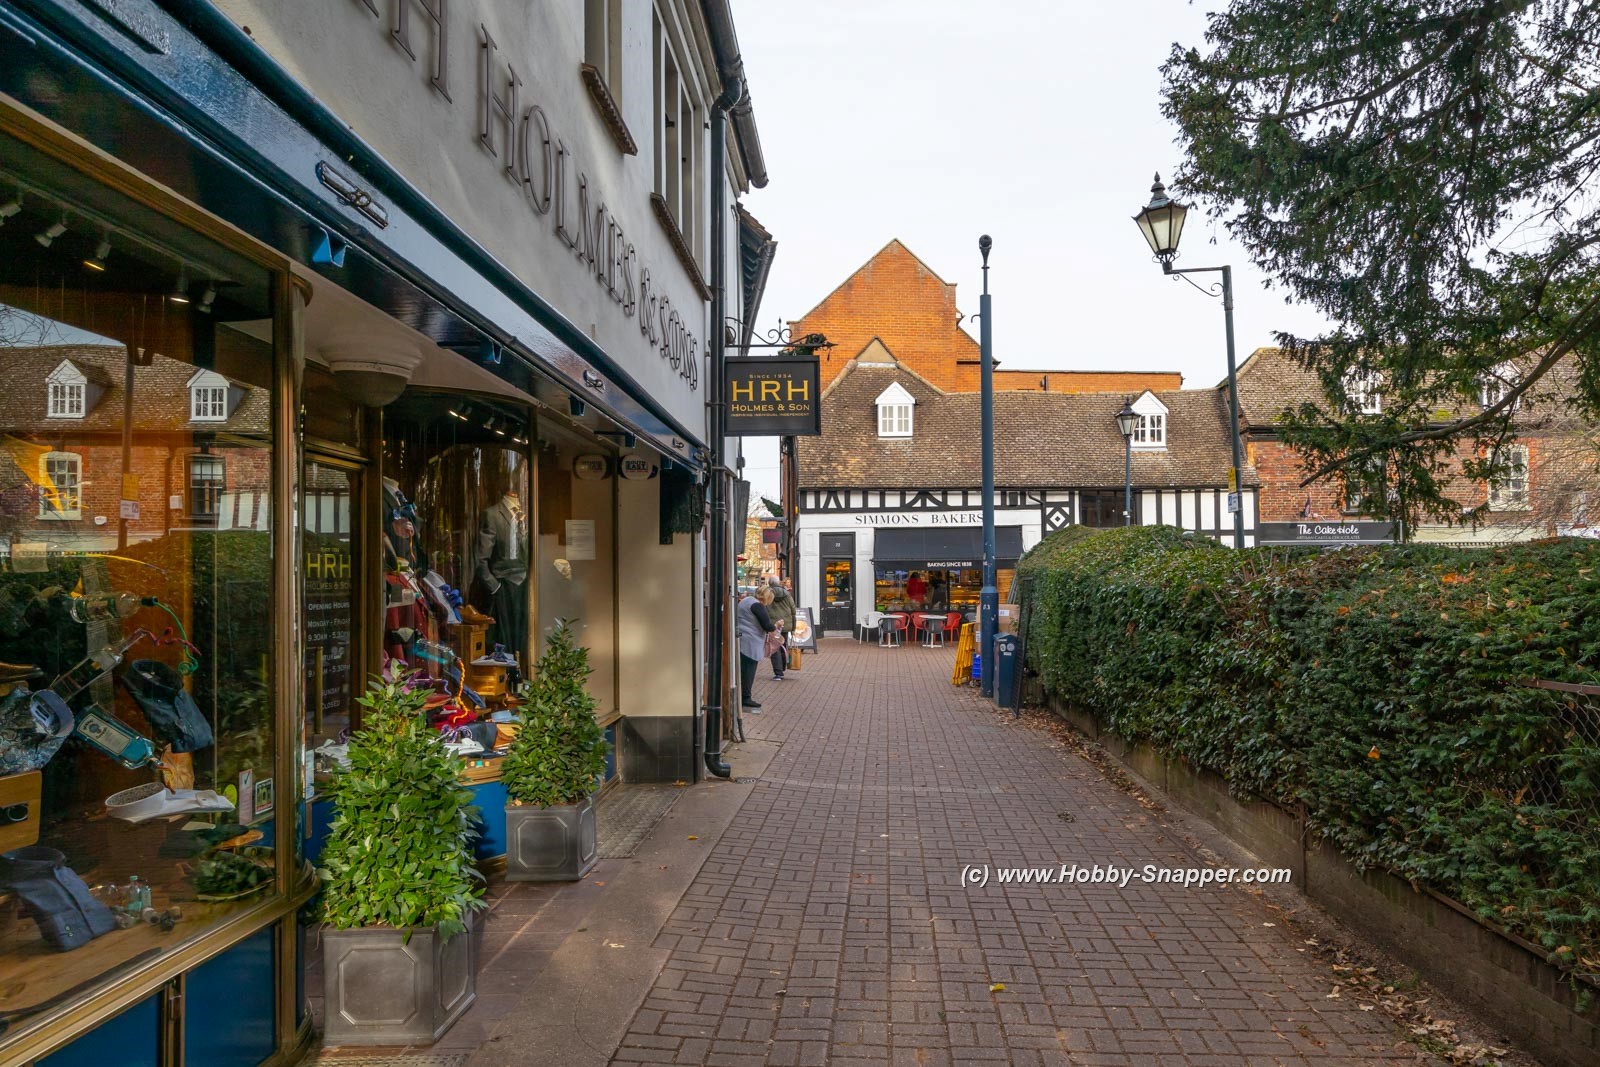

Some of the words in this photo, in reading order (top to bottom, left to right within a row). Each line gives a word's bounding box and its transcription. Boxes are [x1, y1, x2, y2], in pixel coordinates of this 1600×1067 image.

[479, 22, 636, 317] HOLMES
[640, 266, 659, 346] &
[659, 295, 698, 391] SONS
[731, 380, 809, 401] HRH
[731, 404, 774, 412] HOLMES
[777, 403, 785, 411] &
[788, 403, 810, 411] SON
[855, 514, 919, 525] SIMMONS
[931, 513, 983, 524] BAKERS
[1297, 524, 1312, 535] The
[1314, 525, 1337, 535] Cake
[1337, 524, 1359, 535] Hole
[307, 553, 351, 578] HRH
[308, 603, 332, 611] OPENING
